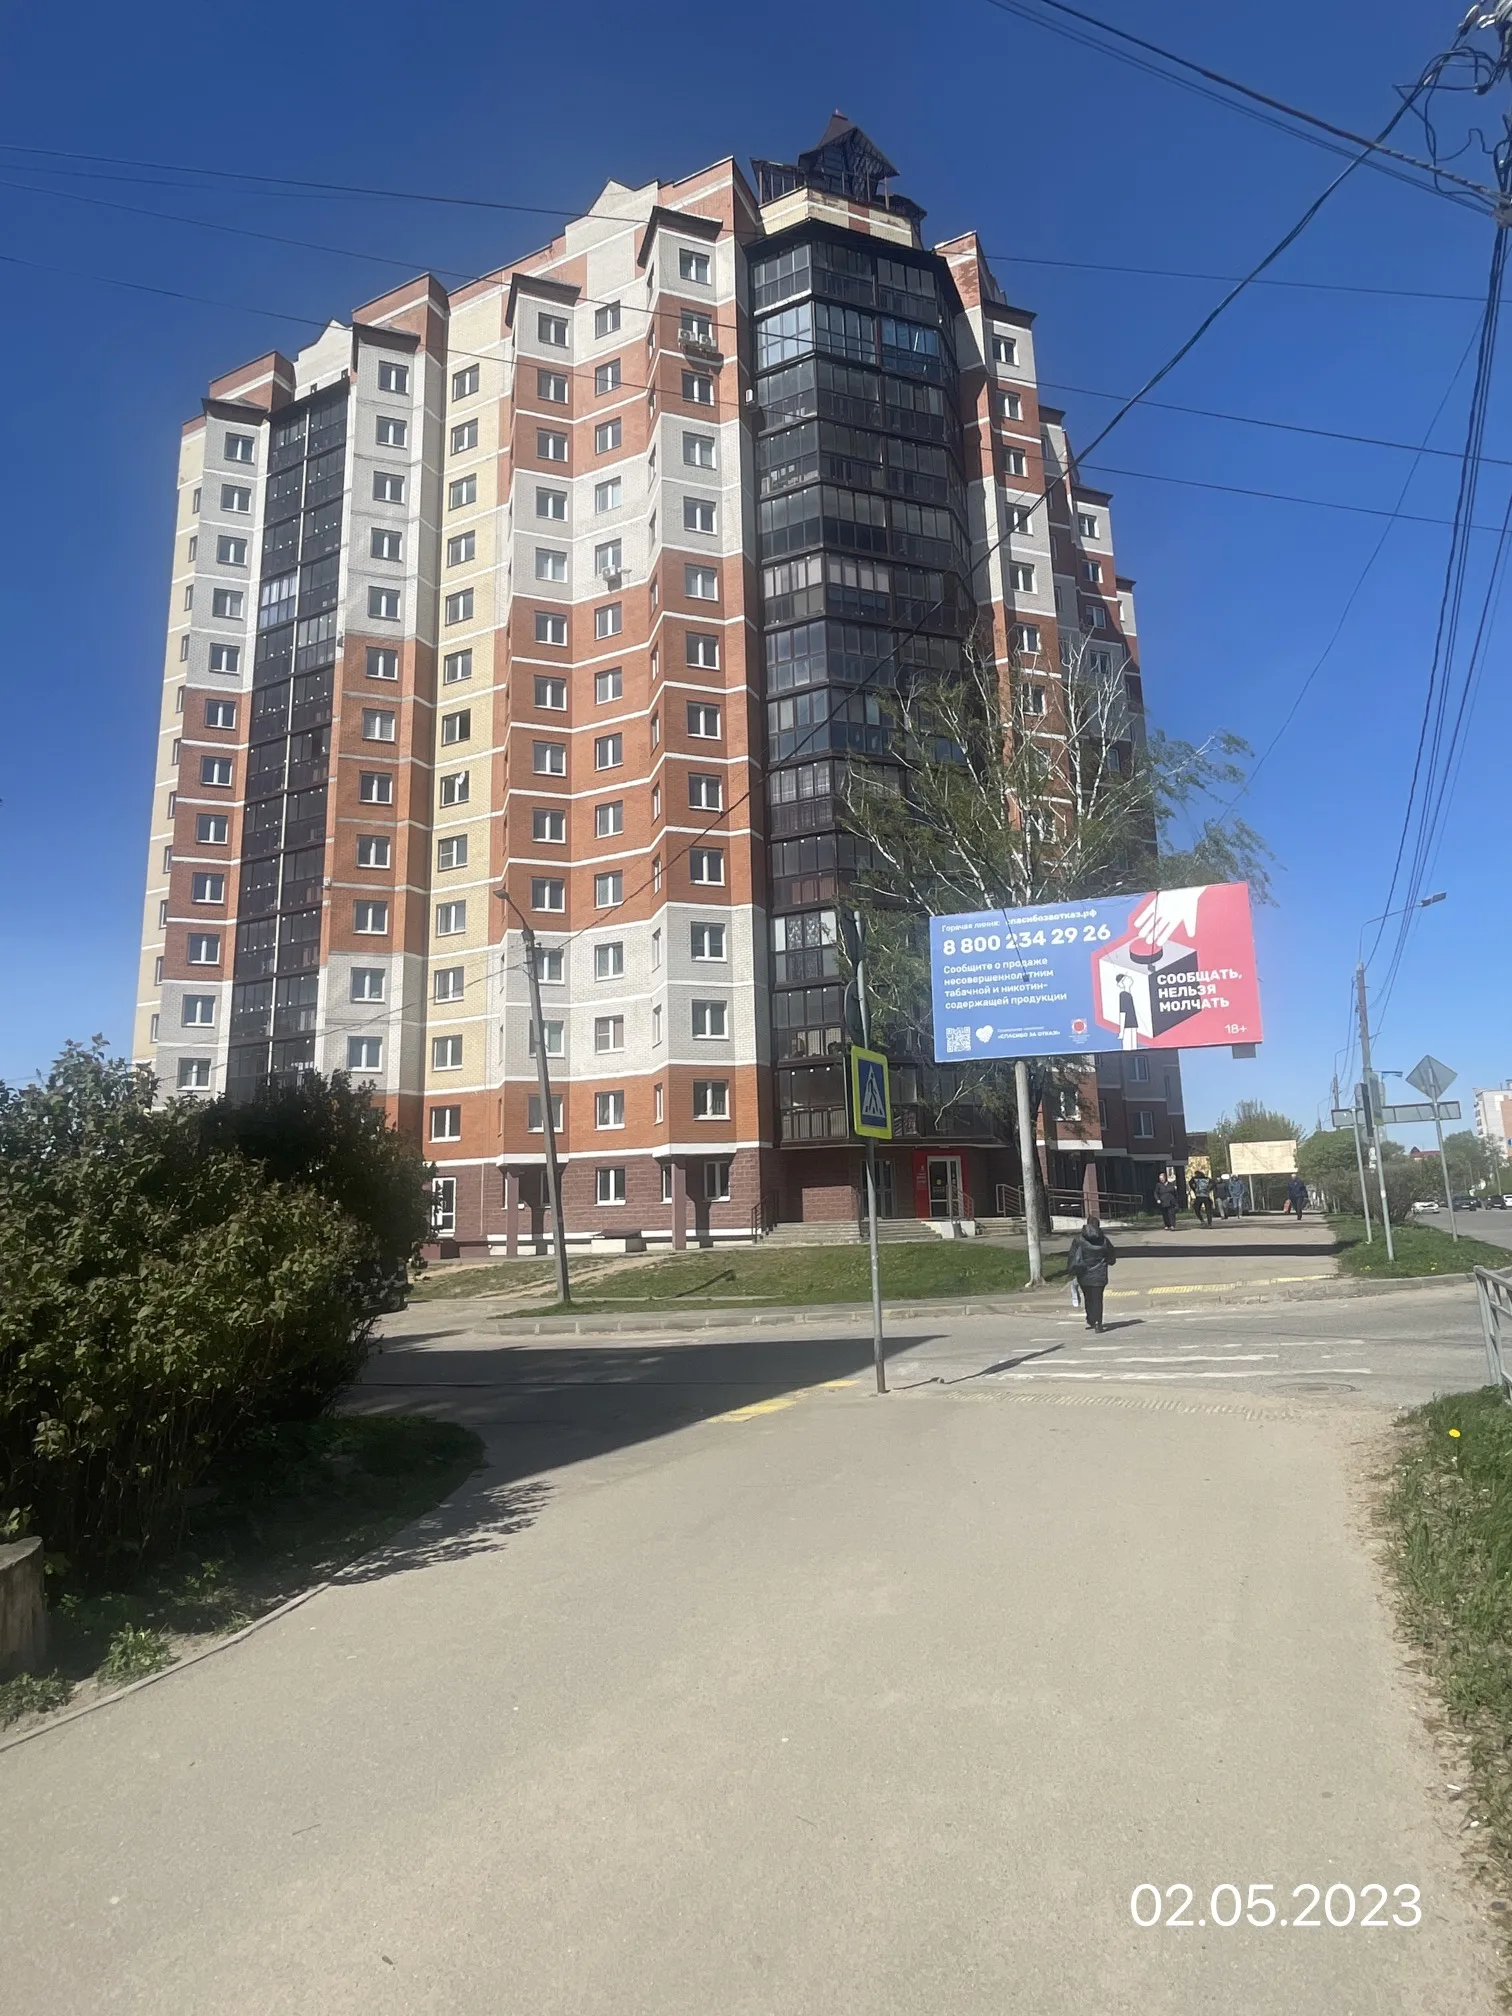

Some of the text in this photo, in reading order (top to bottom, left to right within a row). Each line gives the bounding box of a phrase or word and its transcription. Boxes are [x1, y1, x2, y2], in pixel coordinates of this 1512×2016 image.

[943, 924, 1111, 955] 8 800 234 29 26
[943, 957, 1048, 974] Сообщите о продаже
[944, 969, 1054, 986] несовершеннолтним
[1157, 968, 1243, 985] СООБЩАТЬ,
[945, 983, 1049, 998] табачной и никотин-
[1158, 984, 1217, 999] НЕЛЬЗЯ
[945, 992, 1068, 1010] содержащей продукции
[1159, 997, 1230, 1012] МОЛЧАТЬ
[1224, 1024, 1248, 1035] 18+
